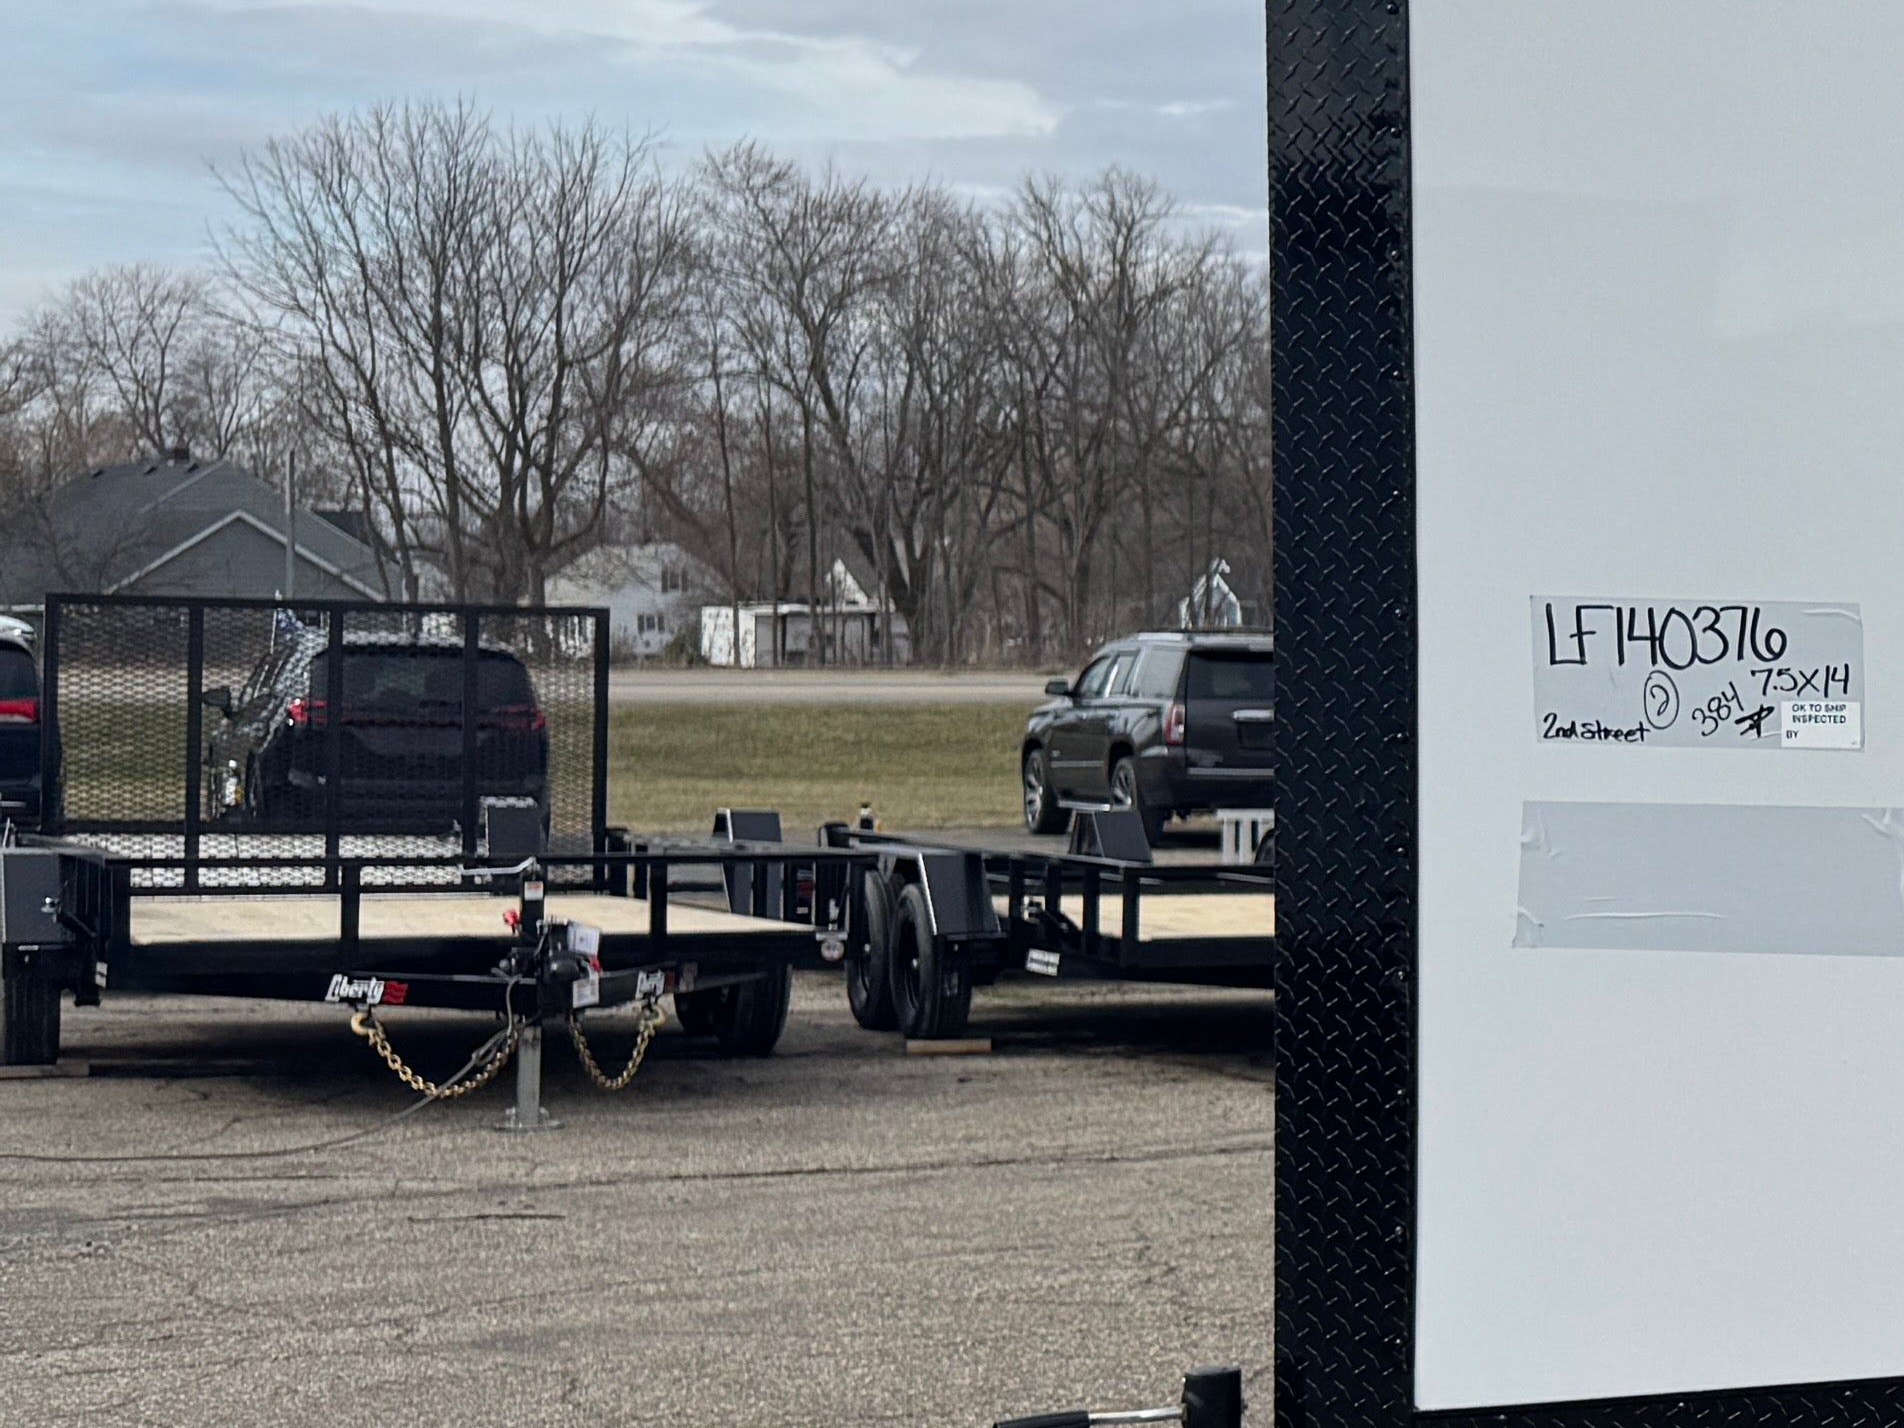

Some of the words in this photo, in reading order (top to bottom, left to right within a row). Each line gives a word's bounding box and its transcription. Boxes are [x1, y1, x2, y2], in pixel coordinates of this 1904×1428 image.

[1545, 602, 1788, 670] LF140376
[1692, 681, 1744, 736] 384
[1792, 704, 1806, 712] OK
[1809, 704, 1822, 712] TO
[1824, 704, 1847, 712] SHIP
[1792, 714, 1847, 724] INSPECTED
[1543, 712, 1579, 739] 2nd
